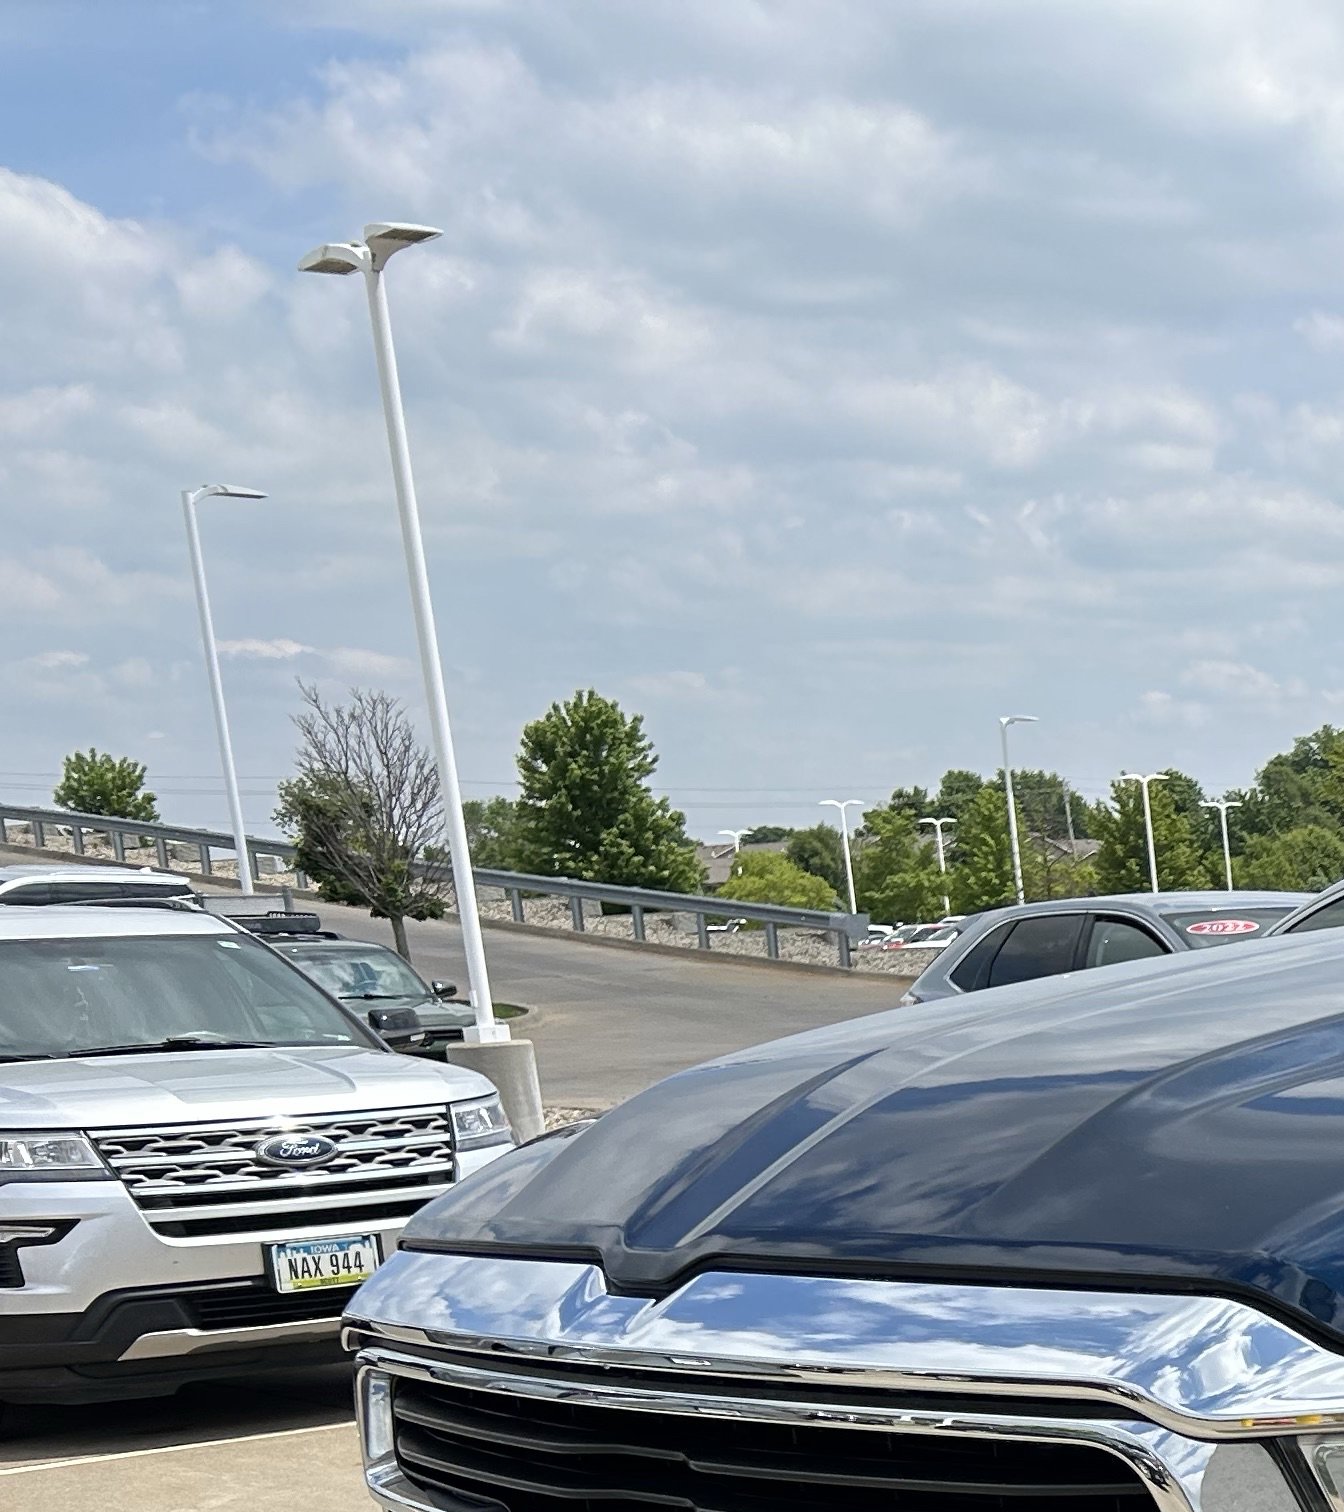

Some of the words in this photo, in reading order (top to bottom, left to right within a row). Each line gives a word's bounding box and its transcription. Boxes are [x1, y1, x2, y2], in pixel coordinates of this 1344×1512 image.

[279, 1137, 321, 1157] Ford
[310, 1243, 340, 1254] IOWA
[288, 1255, 323, 1280] NAX
[329, 1250, 365, 1275] 944
